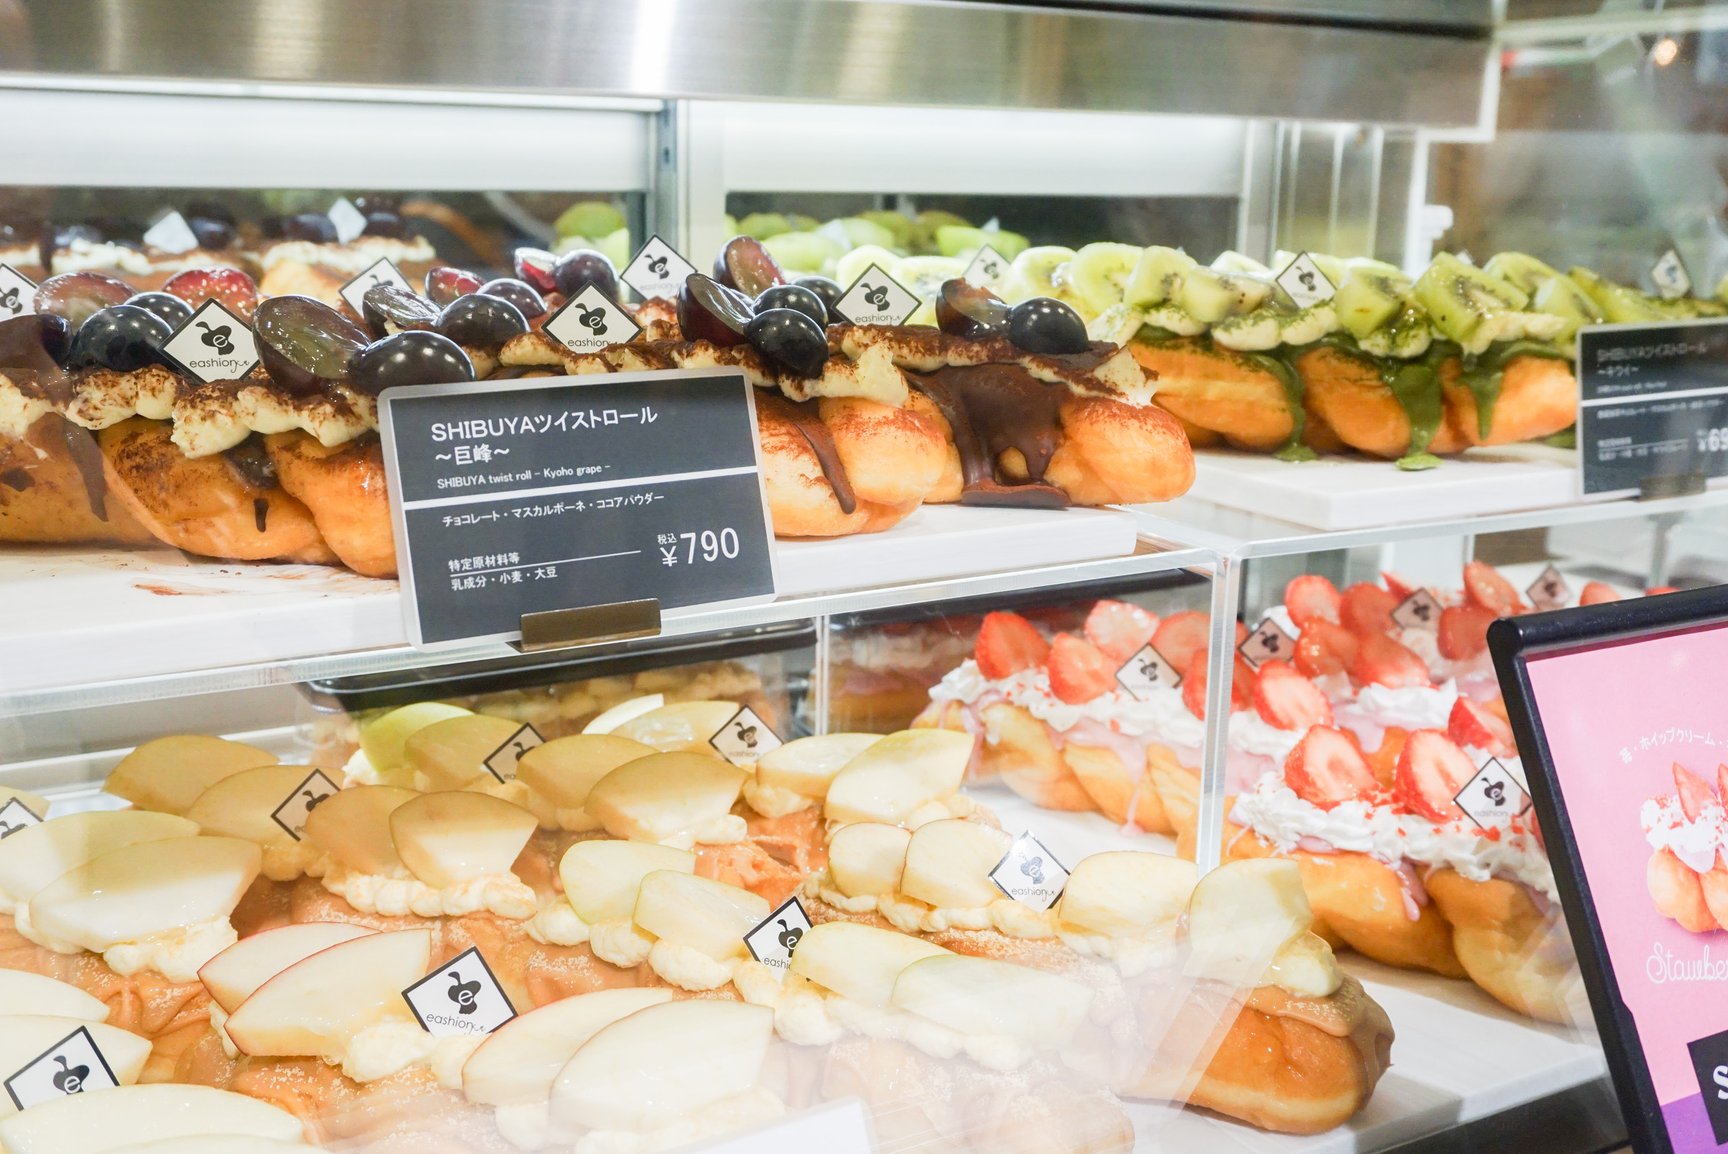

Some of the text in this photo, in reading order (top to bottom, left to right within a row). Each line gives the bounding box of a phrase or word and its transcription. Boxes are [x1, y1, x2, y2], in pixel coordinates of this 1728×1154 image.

[430, 406, 658, 442] SHIBUYAツイストロール
[436, 474, 487, 489] SHIBUYA
[488, 472, 514, 484] twist
[515, 469, 532, 481] roll
[543, 466, 574, 479] Kyoho
[576, 464, 602, 477] grape
[441, 492, 665, 528] チョコレート・マスカルポーネ・ココアパウダー
[657, 533, 677, 545] 税込
[448, 551, 520, 573] 特定原材料等
[451, 566, 558, 591] 乳成分・小麦・大豆
